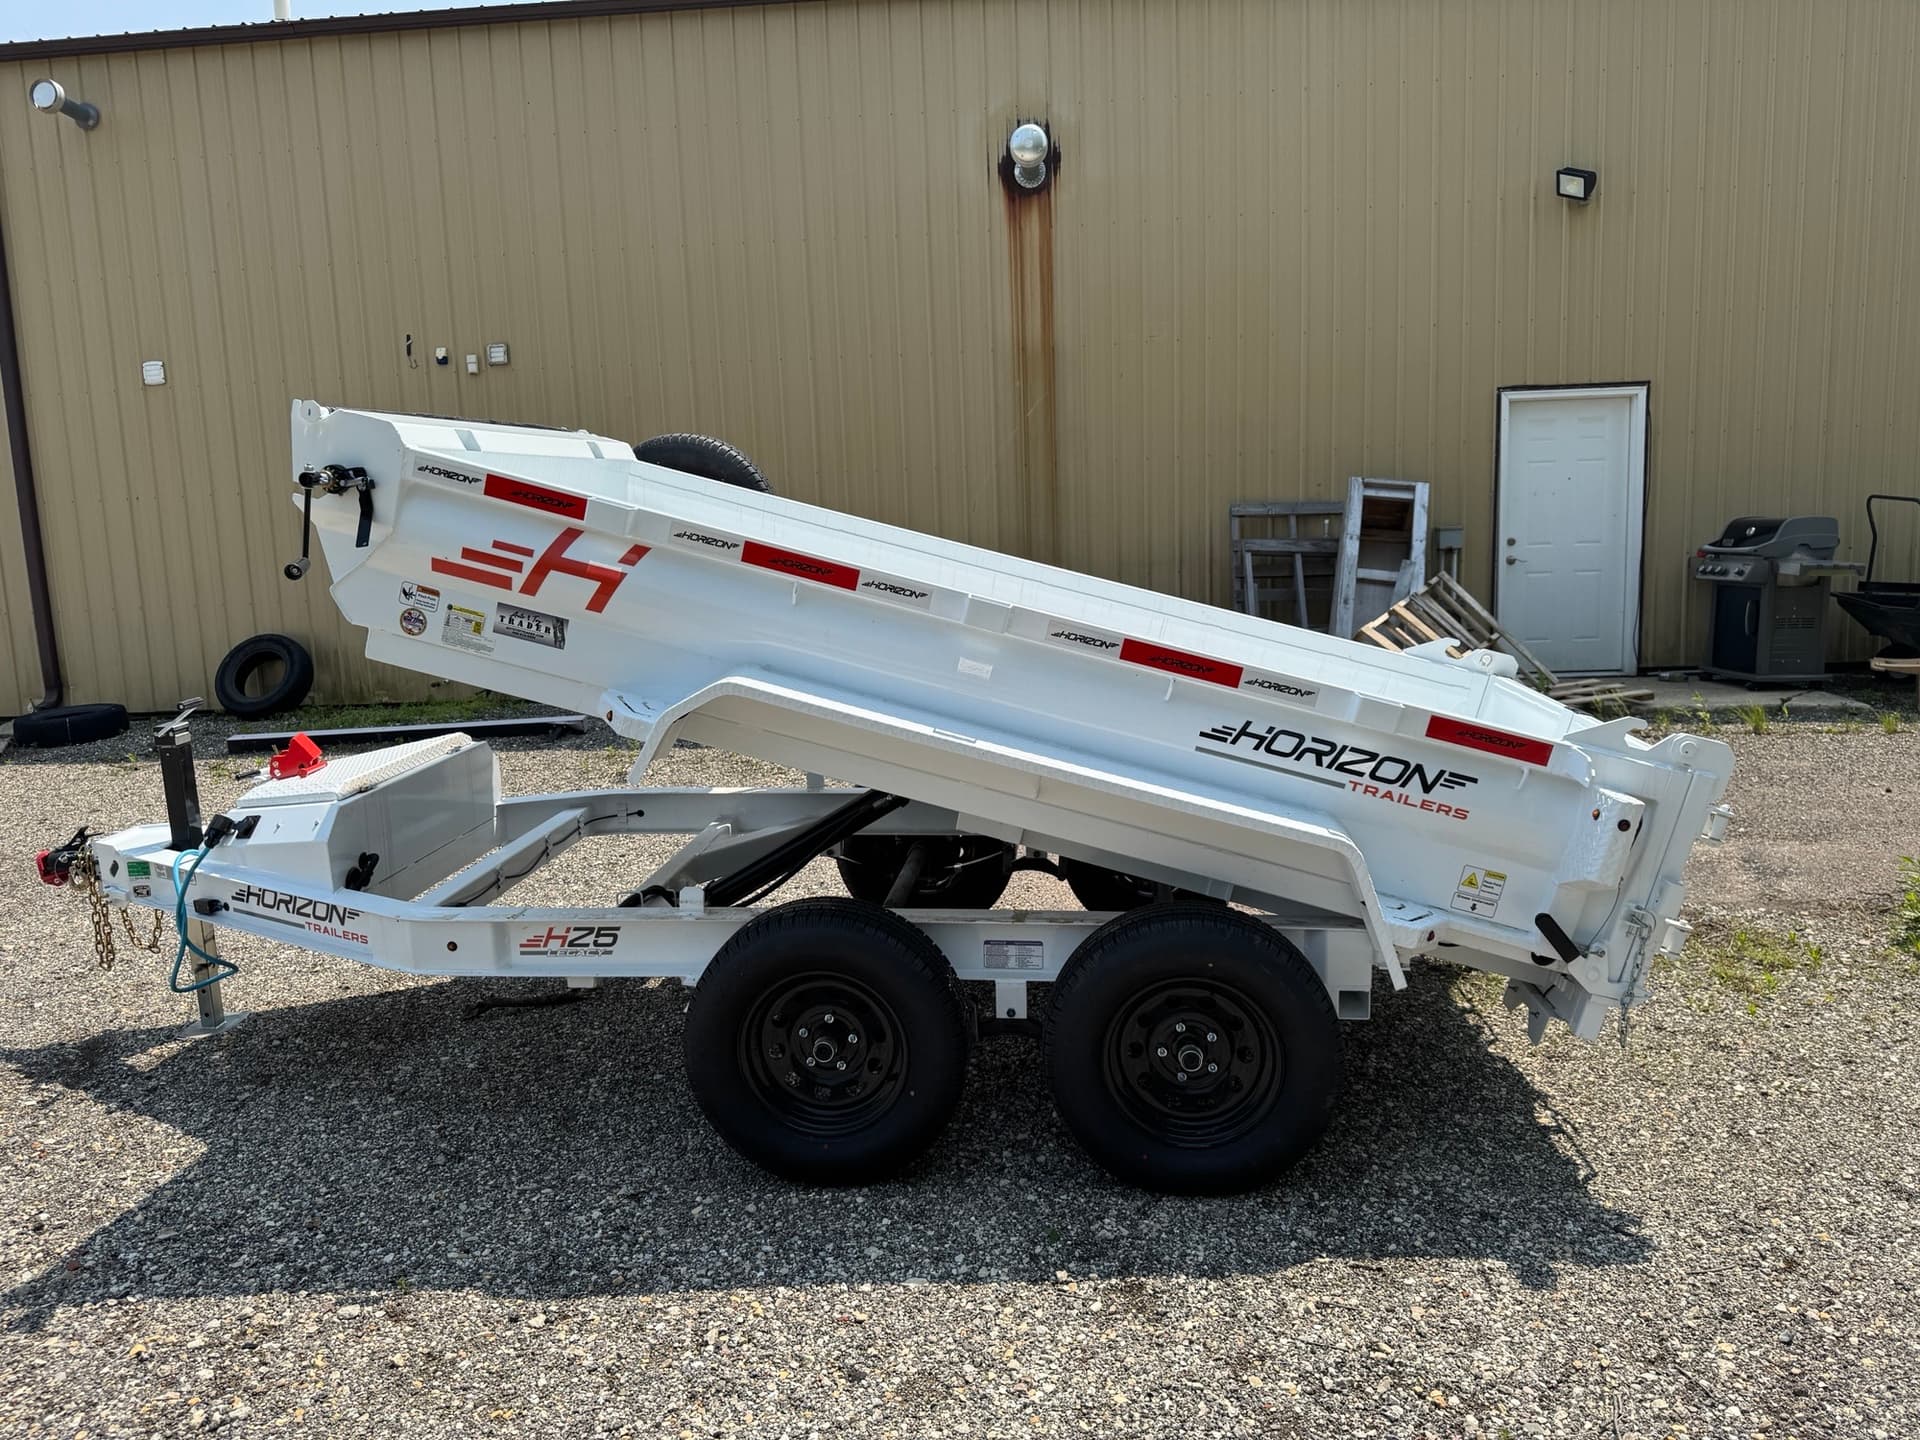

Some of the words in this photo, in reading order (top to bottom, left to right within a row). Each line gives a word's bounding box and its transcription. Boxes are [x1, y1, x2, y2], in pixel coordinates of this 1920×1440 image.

[422, 464, 475, 485] HORIZON
[519, 490, 569, 509] HORIZON
[681, 530, 733, 550] HORIZON
[776, 557, 826, 576] HORIZON
[868, 580, 922, 600] HORIZON
[499, 614, 552, 634] TRADER
[1059, 630, 1112, 650] HORIZON
[1156, 655, 1208, 674] HORIZON
[1252, 678, 1306, 698] HORIZON
[1463, 729, 1520, 751] HORIZON
[1229, 720, 1447, 794] HORIZON
[1348, 780, 1470, 821] TRAILERS
[245, 885, 349, 926] HORIZON
[304, 921, 369, 944] TRAILERS
[546, 948, 606, 958] LEGACY
